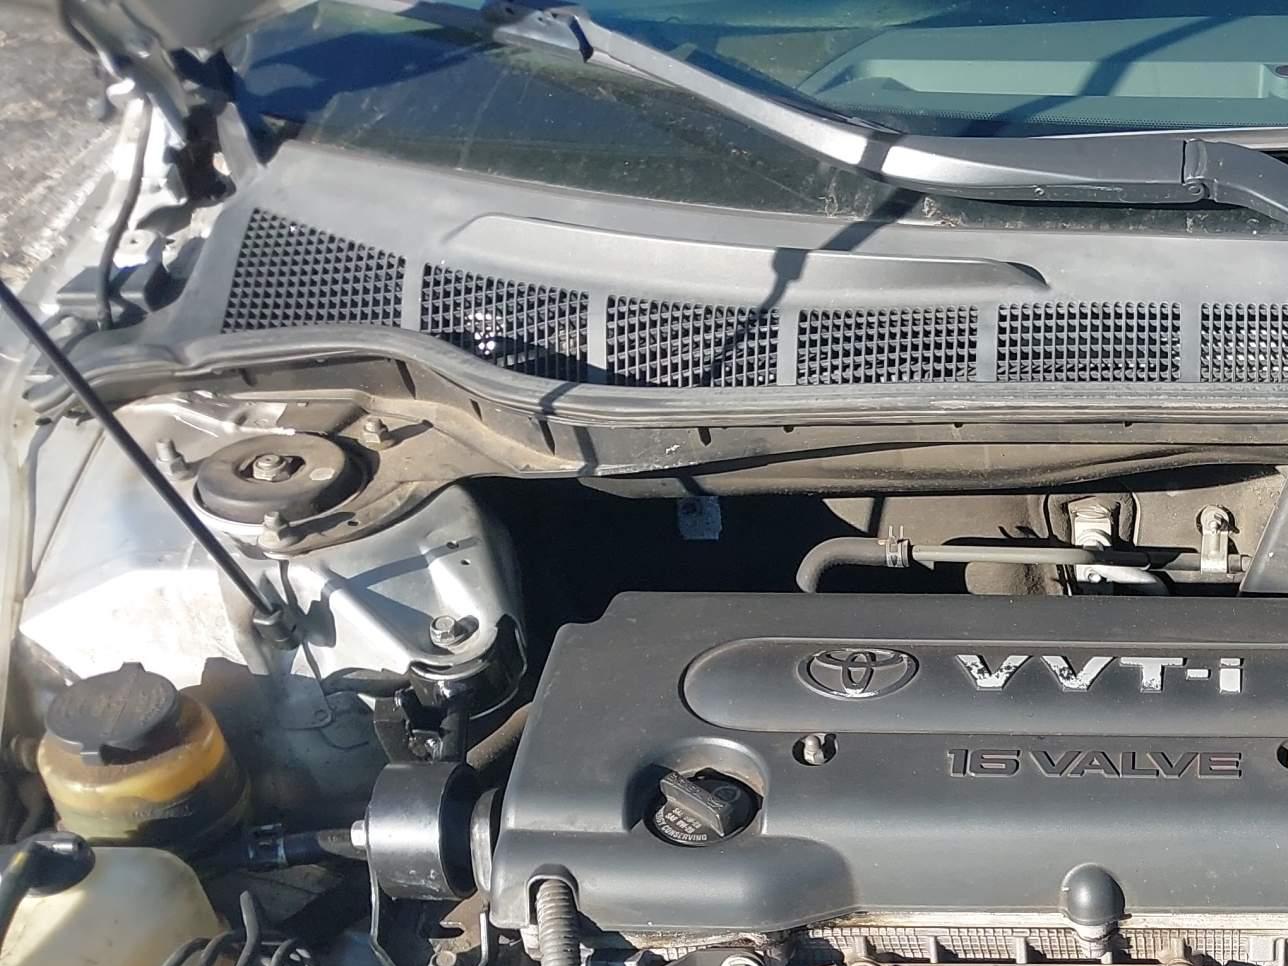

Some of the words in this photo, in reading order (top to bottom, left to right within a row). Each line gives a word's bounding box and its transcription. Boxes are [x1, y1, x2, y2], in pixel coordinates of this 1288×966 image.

[955, 653, 1244, 694] VVT-i
[948, 748, 1021, 778] 16
[1030, 748, 1244, 779] VALVE
[661, 825, 707, 841] CONSERVING
